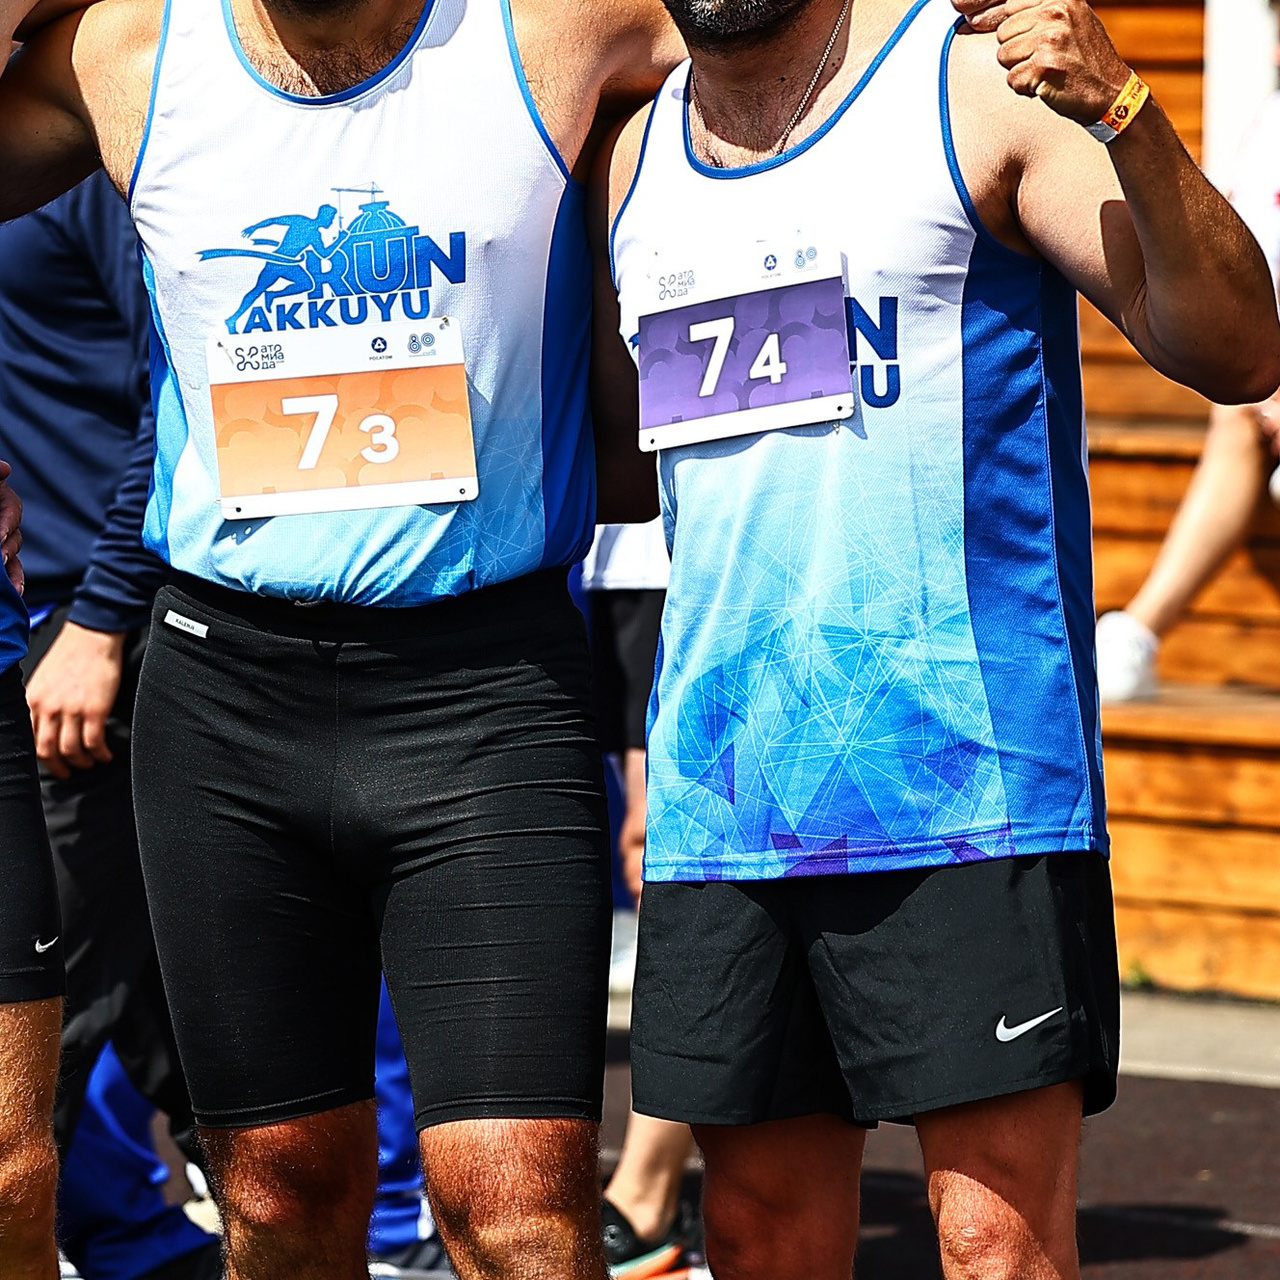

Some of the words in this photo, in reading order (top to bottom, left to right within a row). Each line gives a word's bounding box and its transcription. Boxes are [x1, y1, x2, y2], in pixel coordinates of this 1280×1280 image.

[306, 231, 466, 300] RUN
[242, 289, 430, 334] AKKUYU
[689, 316, 735, 398] 7
[748, 333, 787, 384] 4
[281, 394, 339, 470] 7
[359, 413, 400, 464] 3
